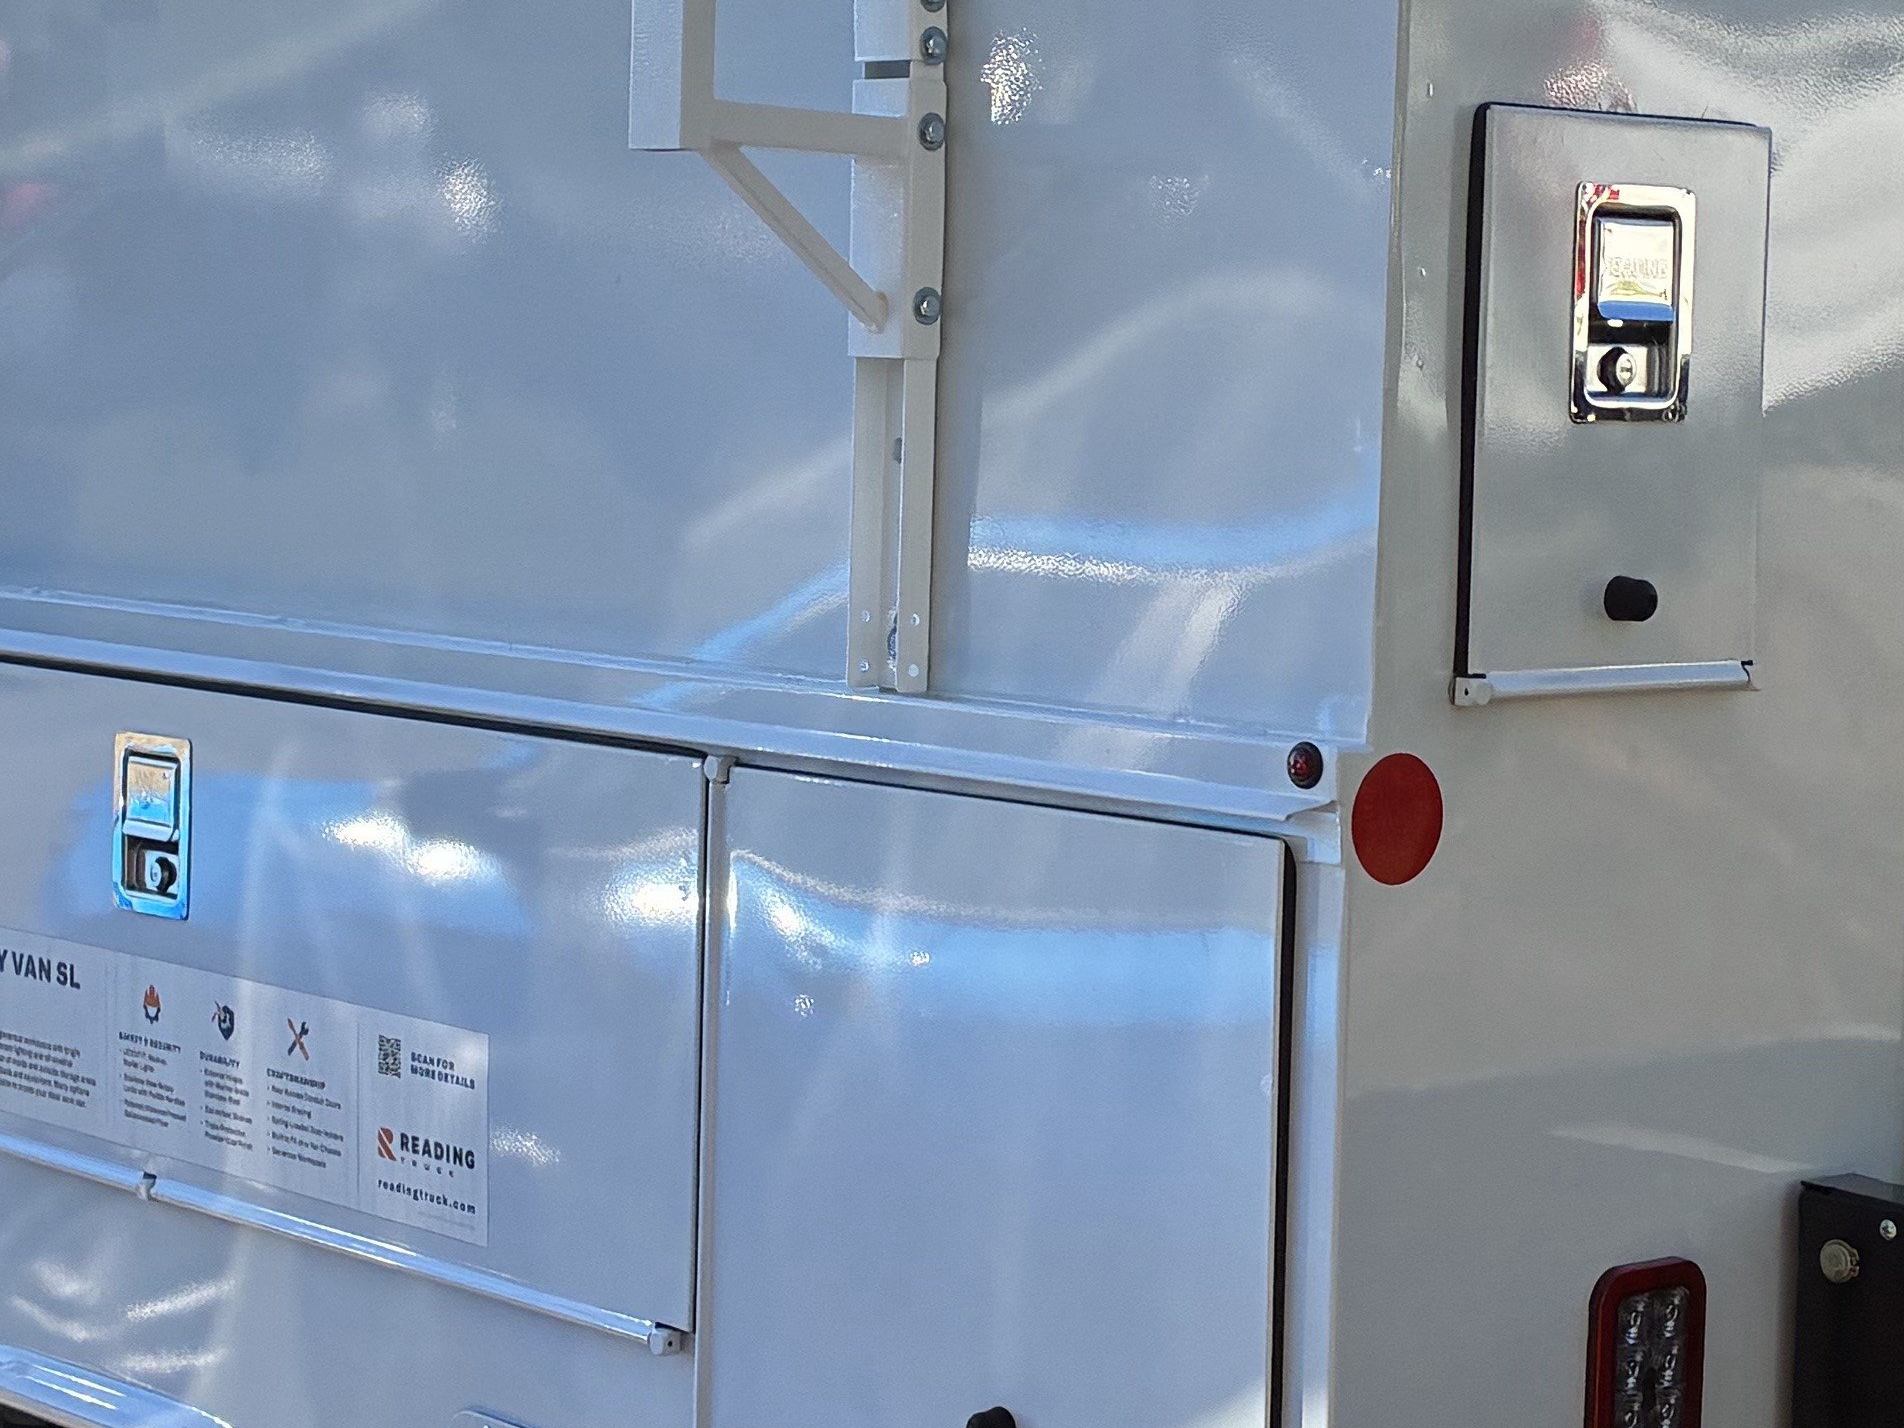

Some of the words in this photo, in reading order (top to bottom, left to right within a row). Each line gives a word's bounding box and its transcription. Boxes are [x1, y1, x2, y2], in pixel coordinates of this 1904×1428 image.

[12, 950, 53, 983] VAN
[56, 963, 81, 989] SL
[410, 1051, 435, 1067] SCAN
[436, 1057, 455, 1071] FOR
[410, 1064, 436, 1080] MORE
[437, 1070, 476, 1090] DETAILS
[400, 1132, 476, 1170] READING
[378, 1179, 476, 1215] readingtruck.com
